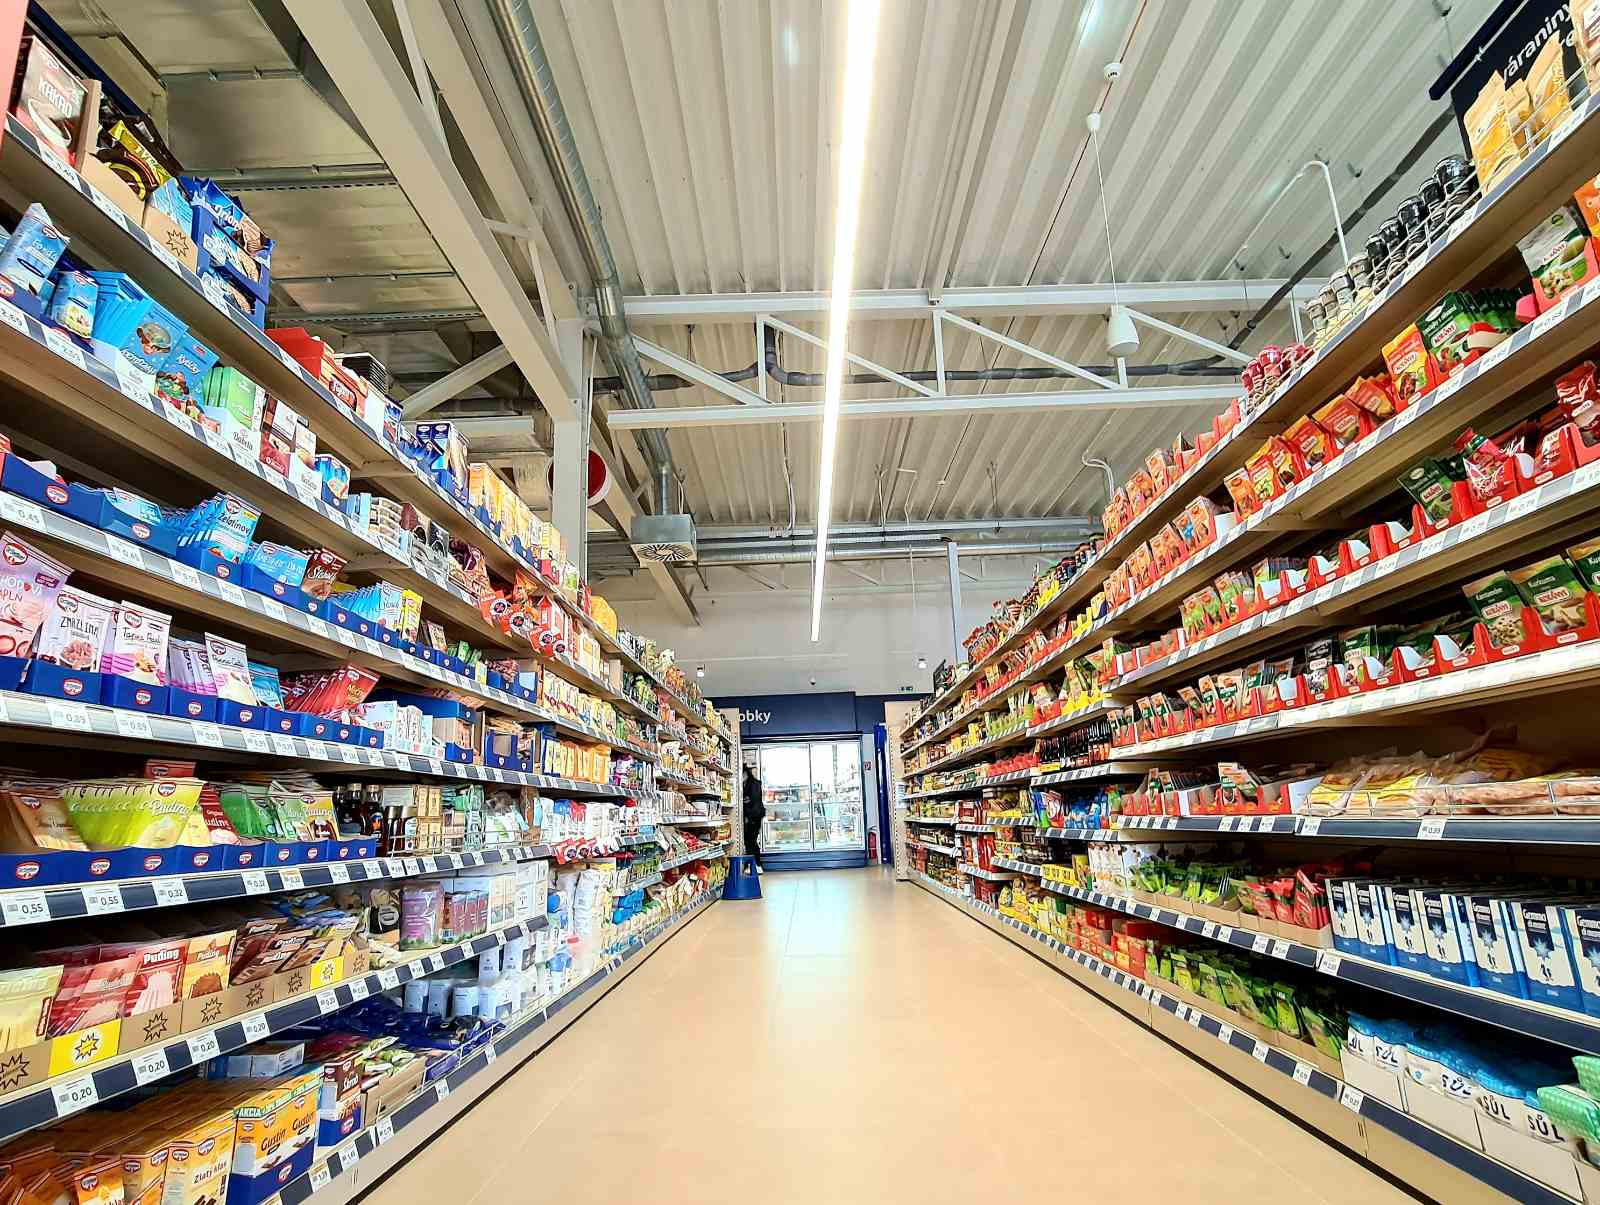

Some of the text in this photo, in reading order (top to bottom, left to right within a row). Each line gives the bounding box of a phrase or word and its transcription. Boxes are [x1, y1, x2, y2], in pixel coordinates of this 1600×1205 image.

[101, 896, 119, 906] 0,55
[22, 903, 44, 915] 0,55
[143, 950, 180, 966] Puding
[201, 1041, 215, 1052] 0,20
[149, 1061, 166, 1073] 0,20
[71, 1086, 92, 1102] 0,20
